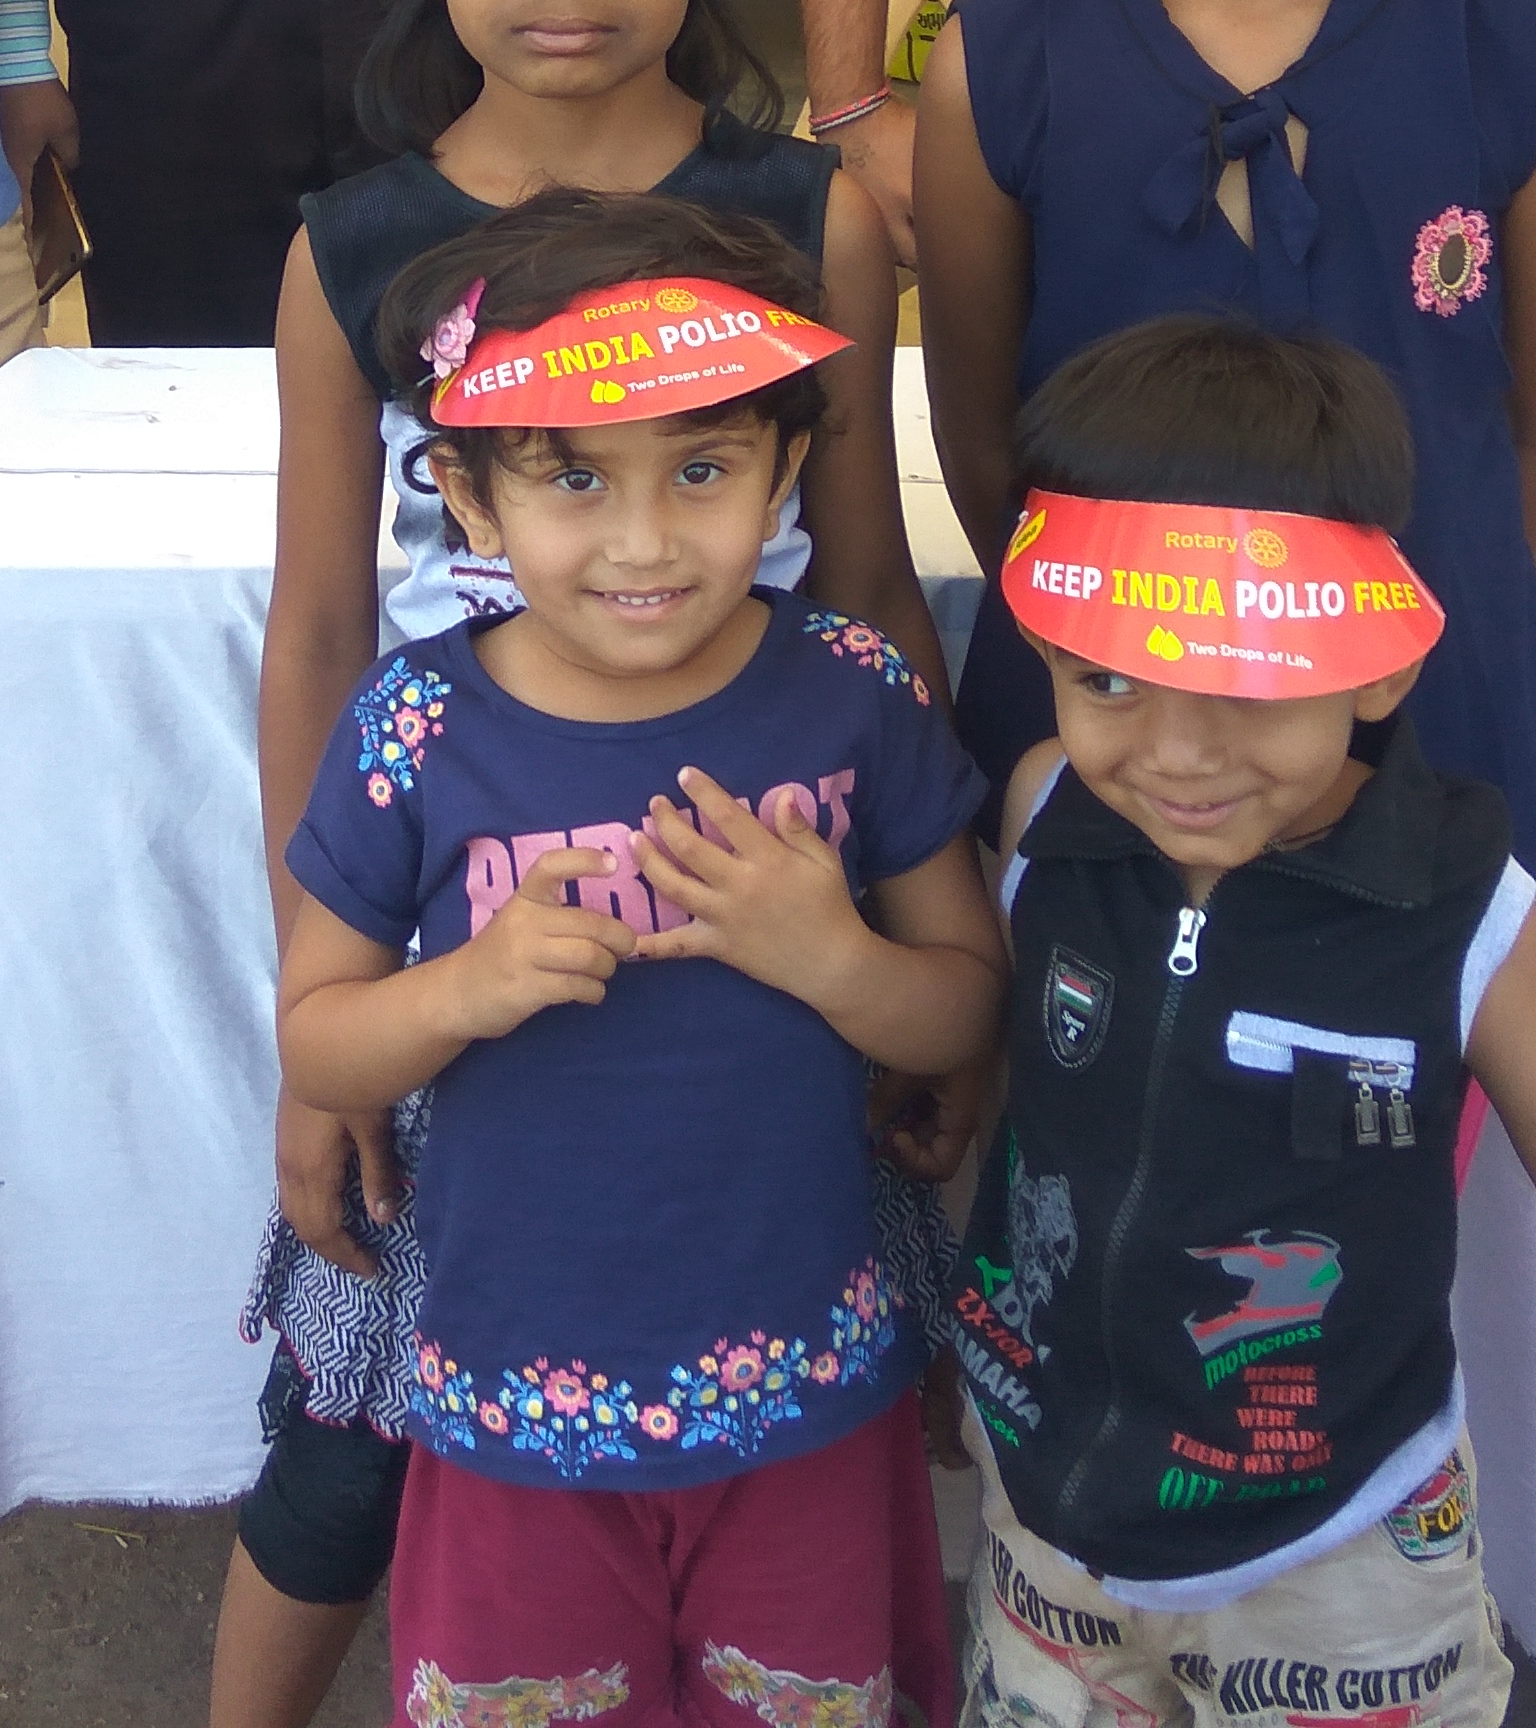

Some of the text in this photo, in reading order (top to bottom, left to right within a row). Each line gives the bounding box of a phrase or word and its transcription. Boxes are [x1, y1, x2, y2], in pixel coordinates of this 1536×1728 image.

[582, 296, 651, 323] Rotary
[463, 356, 535, 398] KEEP
[542, 331, 655, 379] INDIA
[657, 310, 762, 354] POLIO
[627, 362, 746, 394] Two Drops of Life
[1165, 531, 1239, 555] Rotary
[1031, 559, 1421, 620] KEEP INDIA POLIO FREE
[1187, 642, 1314, 670] Two Drops of Life
[1203, 1323, 1323, 1391] motocross
[1249, 1384, 1317, 1407] THERE
[1236, 1407, 1298, 1428] WERE
[1170, 1431, 1238, 1471] THERE
[1243, 1453, 1285, 1474] WAS
[1012, 1569, 1122, 1647] COTTON
[1218, 1657, 1331, 1716] KILLER
[1335, 1641, 1463, 1710] COTTON
